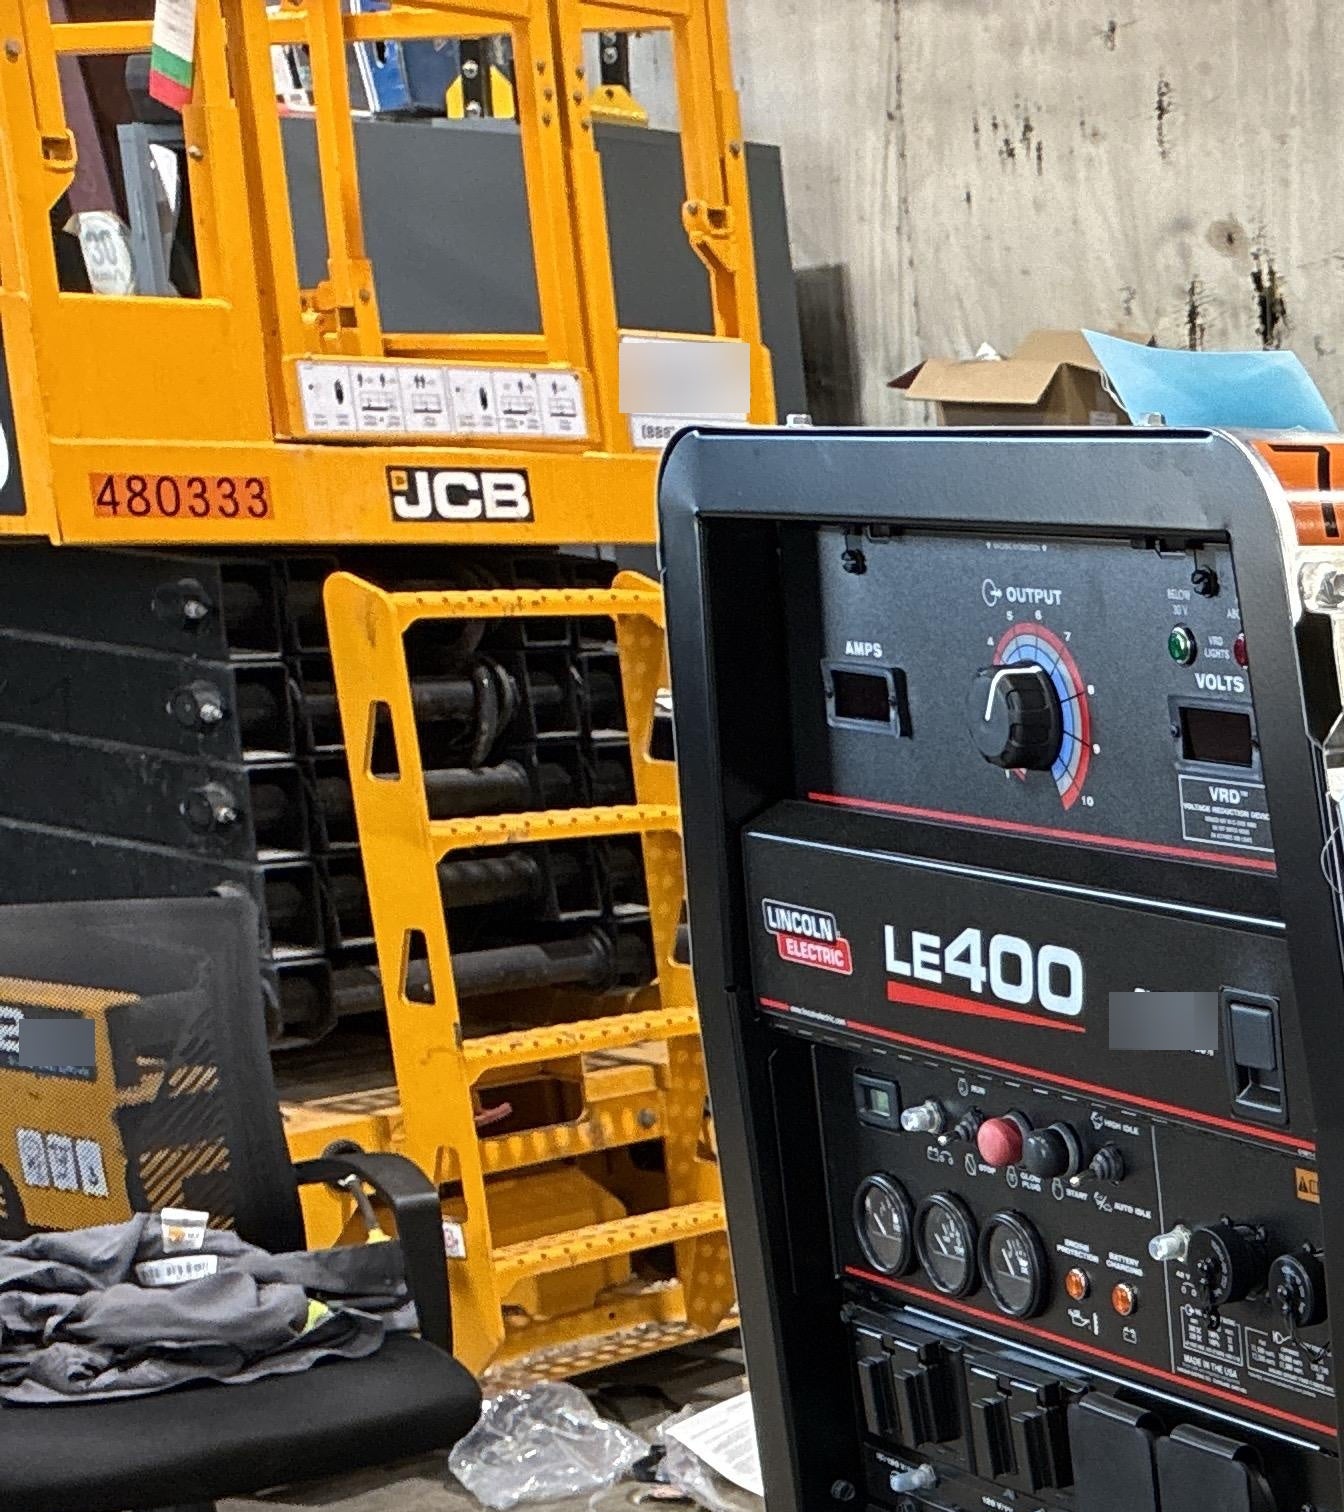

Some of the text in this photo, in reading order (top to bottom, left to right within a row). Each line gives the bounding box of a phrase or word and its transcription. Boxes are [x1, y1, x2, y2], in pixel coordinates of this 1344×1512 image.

[95, 474, 270, 518] 480333
[393, 469, 530, 519] JCB
[1006, 586, 1062, 605] OUTPUT
[987, 636, 994, 647] 4
[1063, 631, 1071, 642] 7
[845, 640, 883, 658] AMPS
[1194, 672, 1245, 693] VOLTS
[1081, 795, 1094, 807] 10
[766, 905, 833, 941] LINCOLN
[785, 937, 845, 968] ELECTRIC
[884, 924, 1084, 1017] LE400
[1066, 1187, 1088, 1200] START
[1108, 1251, 1140, 1267] BATTERY
